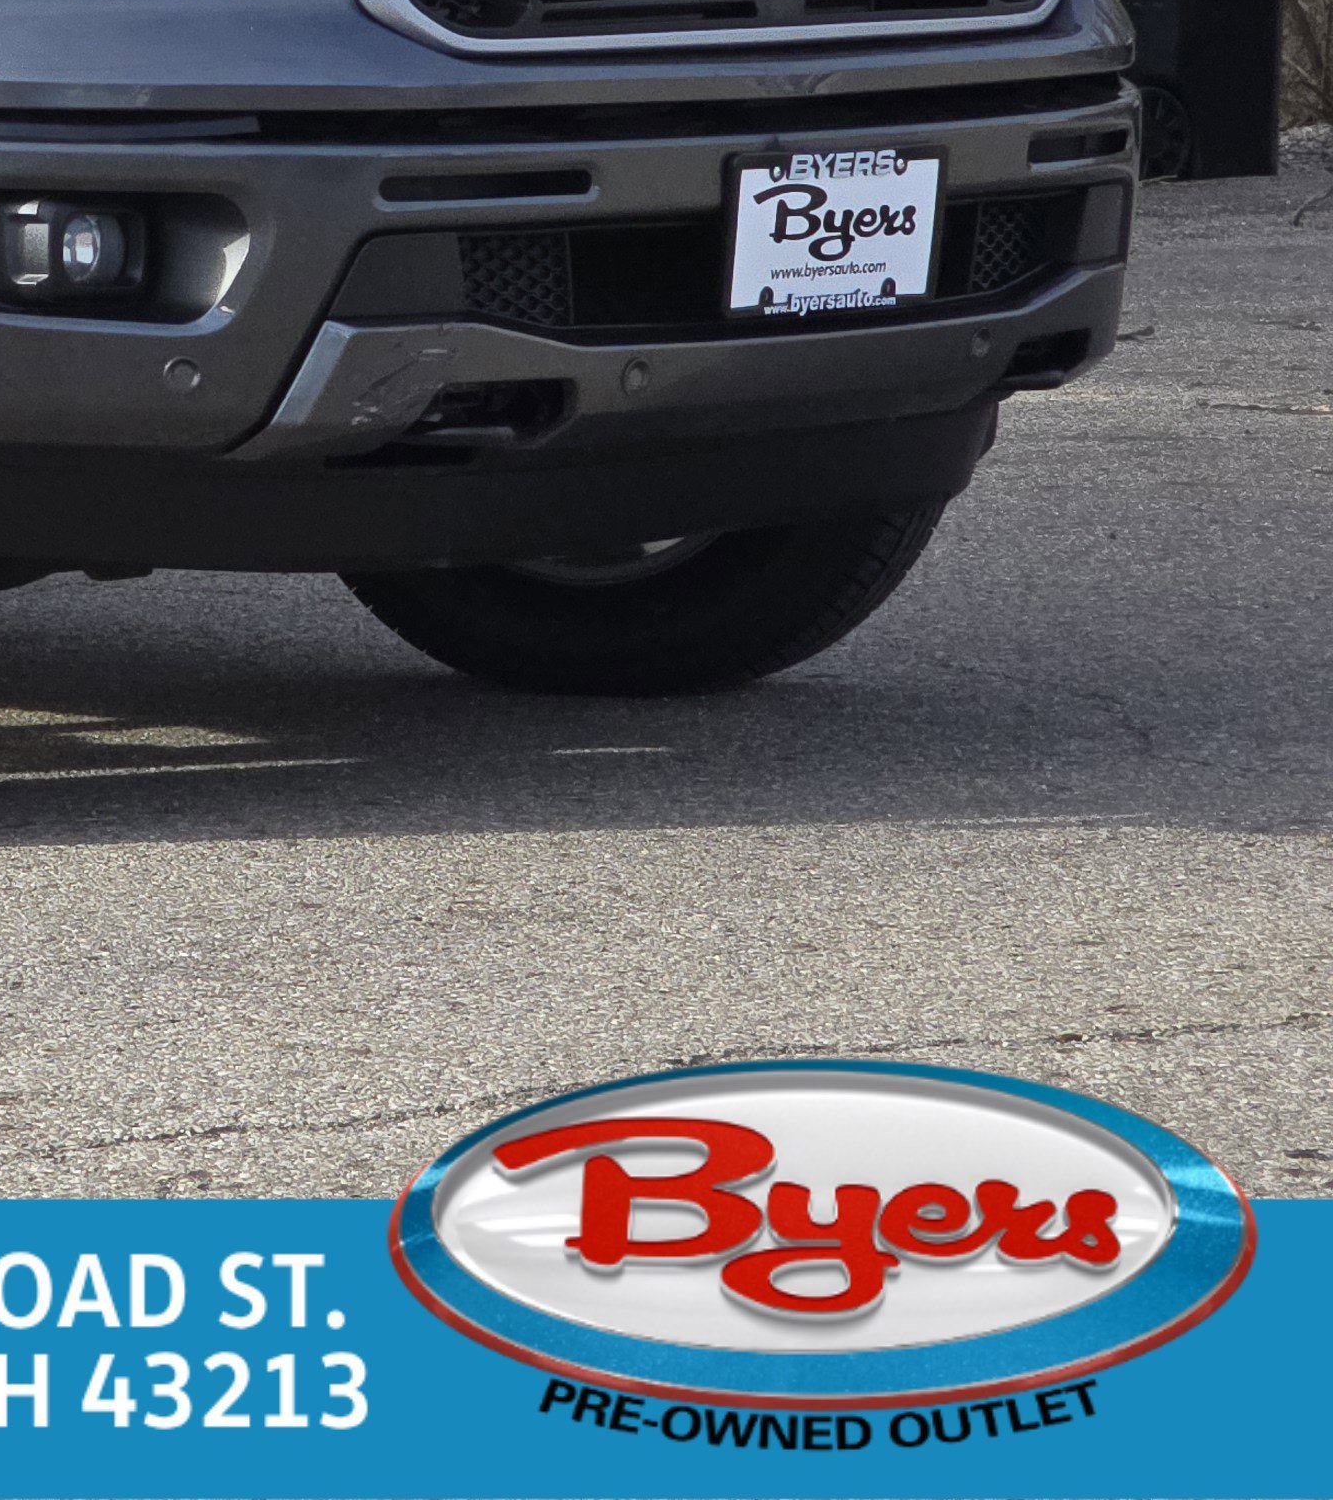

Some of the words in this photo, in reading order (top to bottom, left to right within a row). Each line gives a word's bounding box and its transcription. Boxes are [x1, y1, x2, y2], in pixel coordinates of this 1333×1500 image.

[789, 150, 896, 180] BYERS
[753, 183, 916, 262] Byers
[770, 261, 886, 281] www.byersauto.com
[763, 288, 897, 317] www.byersauto.com
